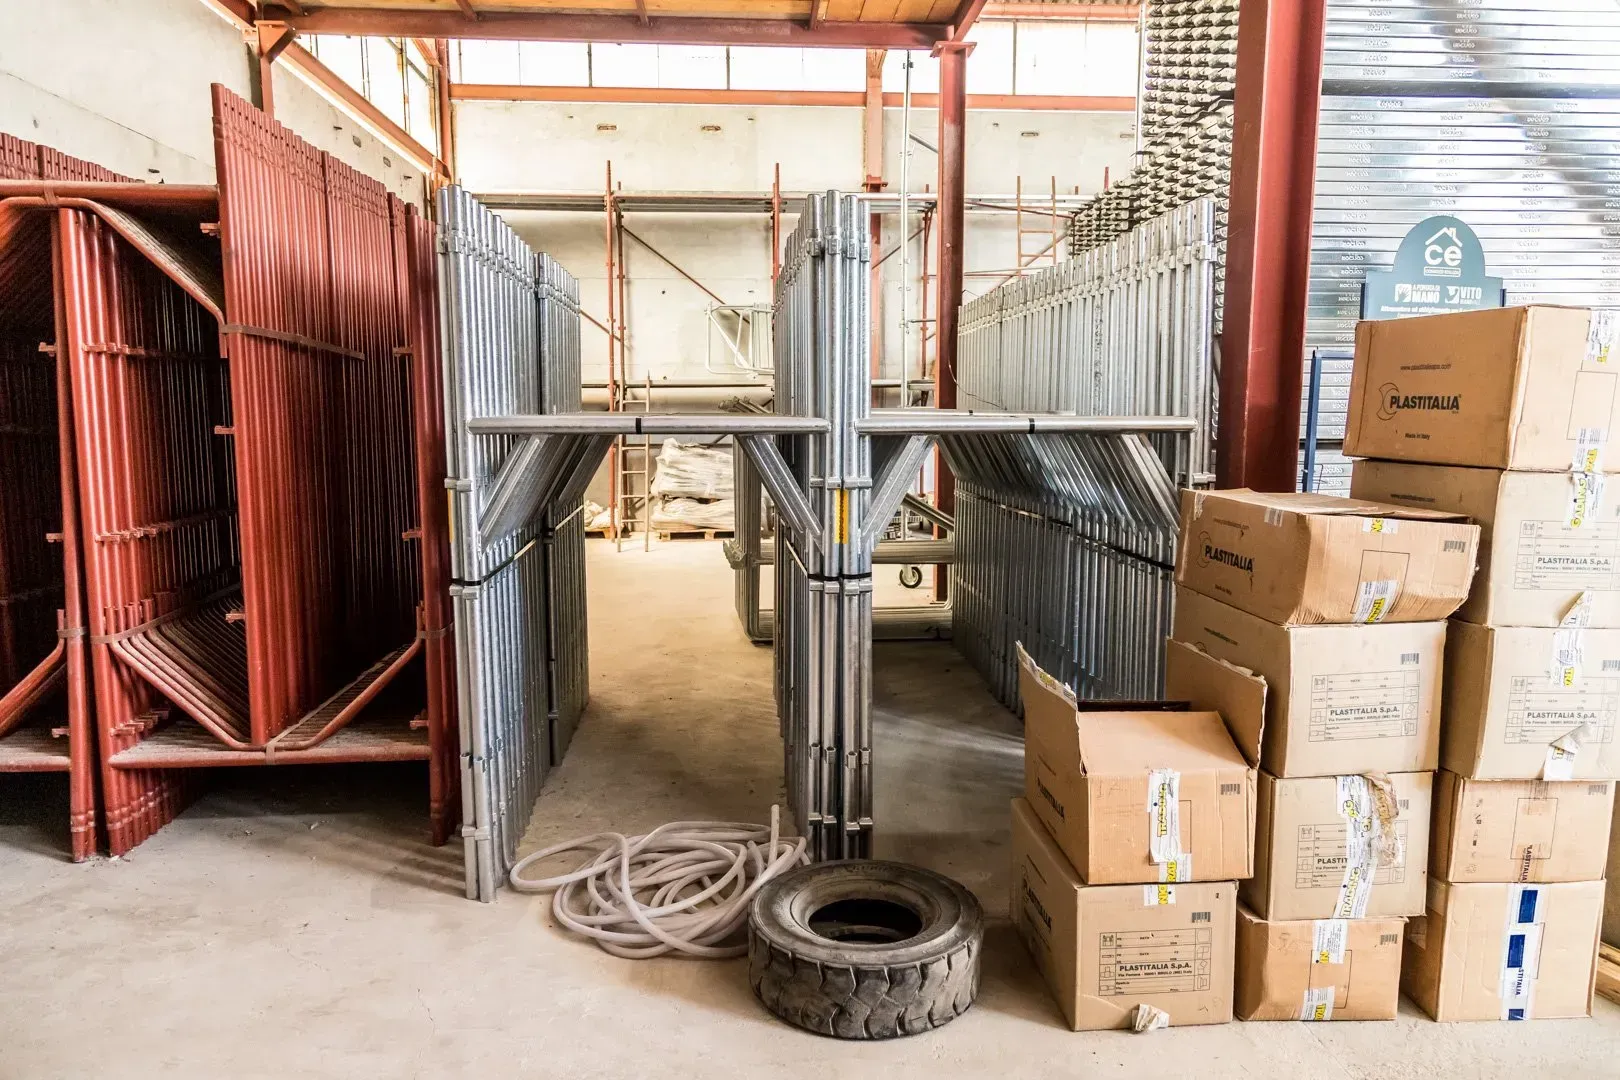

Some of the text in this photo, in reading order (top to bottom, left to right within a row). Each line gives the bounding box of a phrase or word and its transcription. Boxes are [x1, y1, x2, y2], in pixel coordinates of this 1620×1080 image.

[1412, 291, 1440, 303] MANO
[1460, 286, 1482, 299] VITO
[1389, 395, 1460, 411] PLASTITALIA
[1204, 545, 1253, 573] PLASTITALIA
[1537, 557, 1611, 566] PLASTITALIA S.p.A.
[1330, 708, 1378, 716] PLASTITALIA
[1156, 783, 1168, 837] TRADING
[1317, 857, 1348, 865] PLASTIT
[1119, 962, 1192, 972] PLASTITALIA S.p.A.
[1515, 968, 1525, 996] STITALIA
